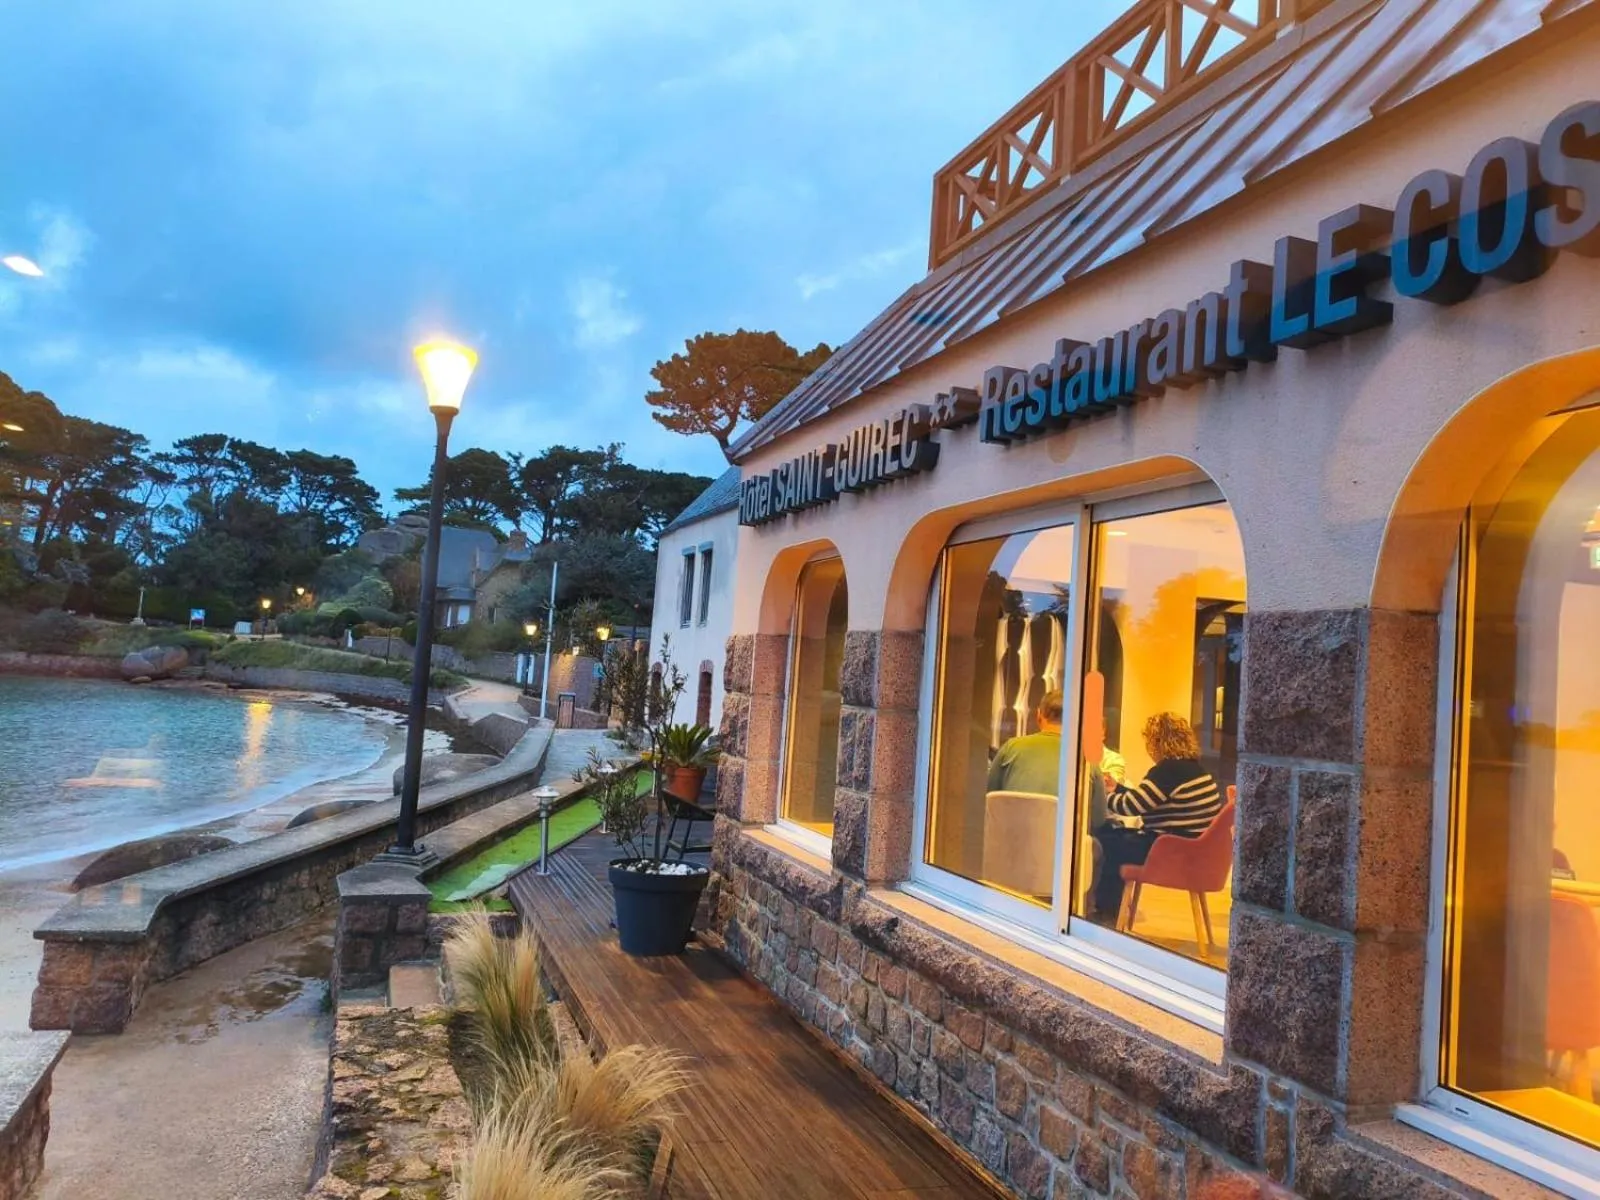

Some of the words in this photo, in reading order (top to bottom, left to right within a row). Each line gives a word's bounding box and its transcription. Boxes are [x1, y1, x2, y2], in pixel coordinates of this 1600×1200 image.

[738, 471, 773, 525] Hôtel
[775, 408, 919, 512] SAINT-GUIREC
[979, 260, 1248, 442] Restaurant
[1270, 204, 1361, 343] LE
[1391, 101, 1600, 297] COS
